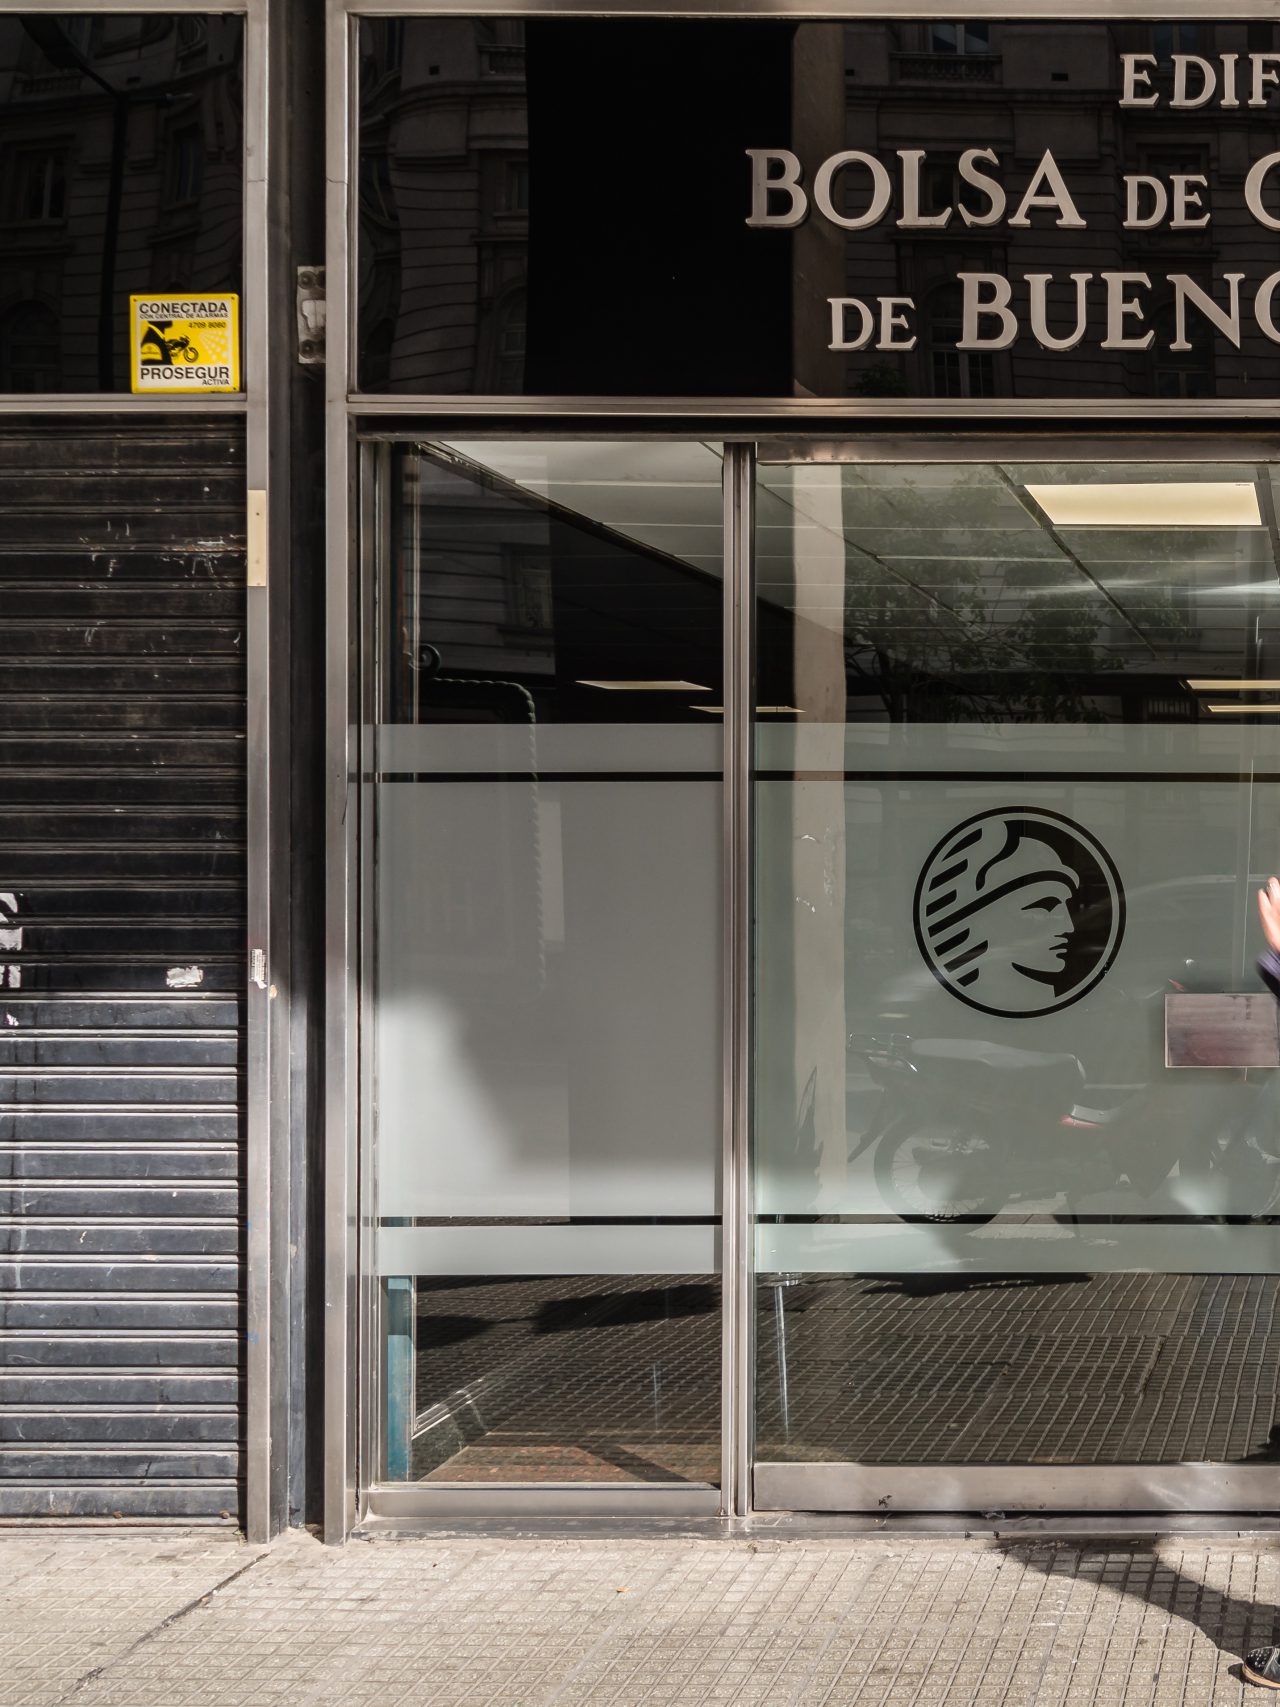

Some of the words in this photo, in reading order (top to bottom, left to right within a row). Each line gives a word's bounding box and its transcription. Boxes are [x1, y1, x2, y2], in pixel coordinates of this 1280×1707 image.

[745, 148, 1087, 230] BOLSA
[1122, 175, 1211, 229] DE
[139, 302, 228, 314] CONECTADA
[827, 297, 917, 351] DE
[140, 366, 230, 380] PROSEGUR
